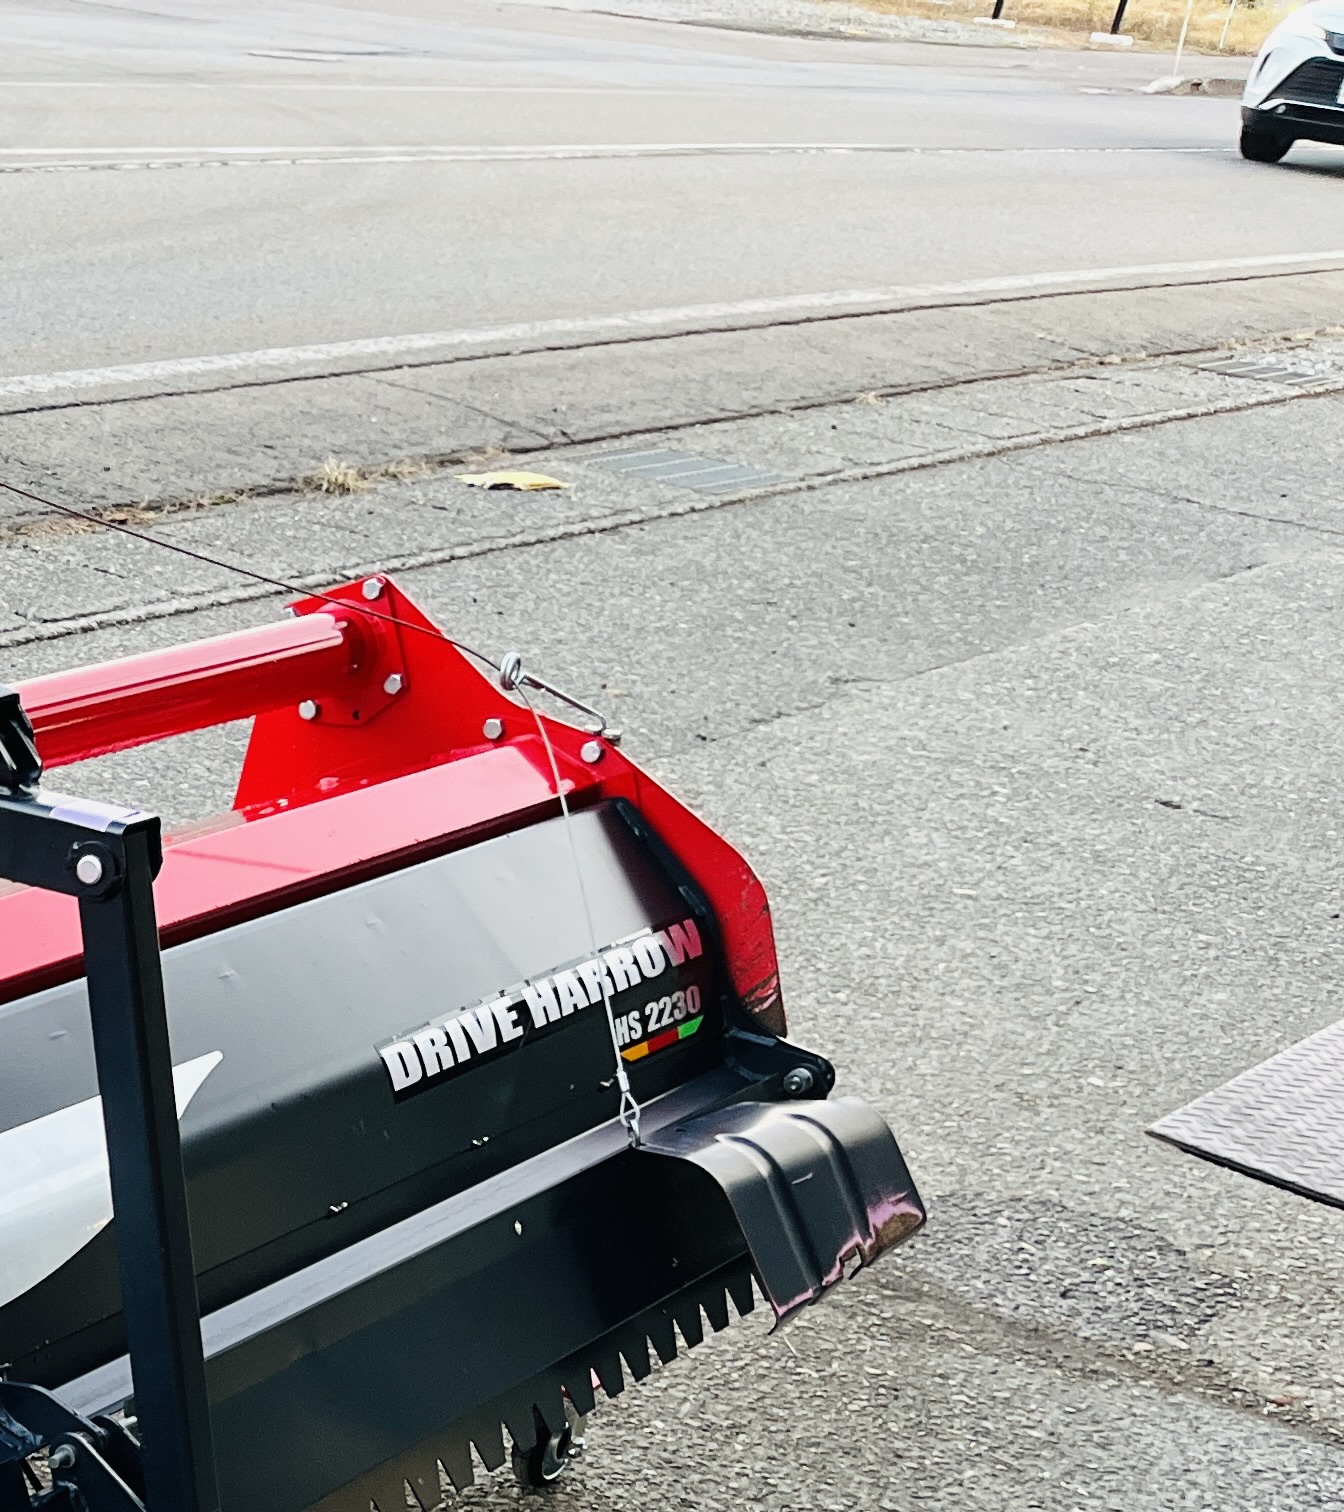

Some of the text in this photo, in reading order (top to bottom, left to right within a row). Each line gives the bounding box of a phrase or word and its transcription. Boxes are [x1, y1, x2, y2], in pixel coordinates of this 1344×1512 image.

[380, 918, 704, 1092] DRIVE HARROW
[615, 985, 701, 1046] HS 2230
